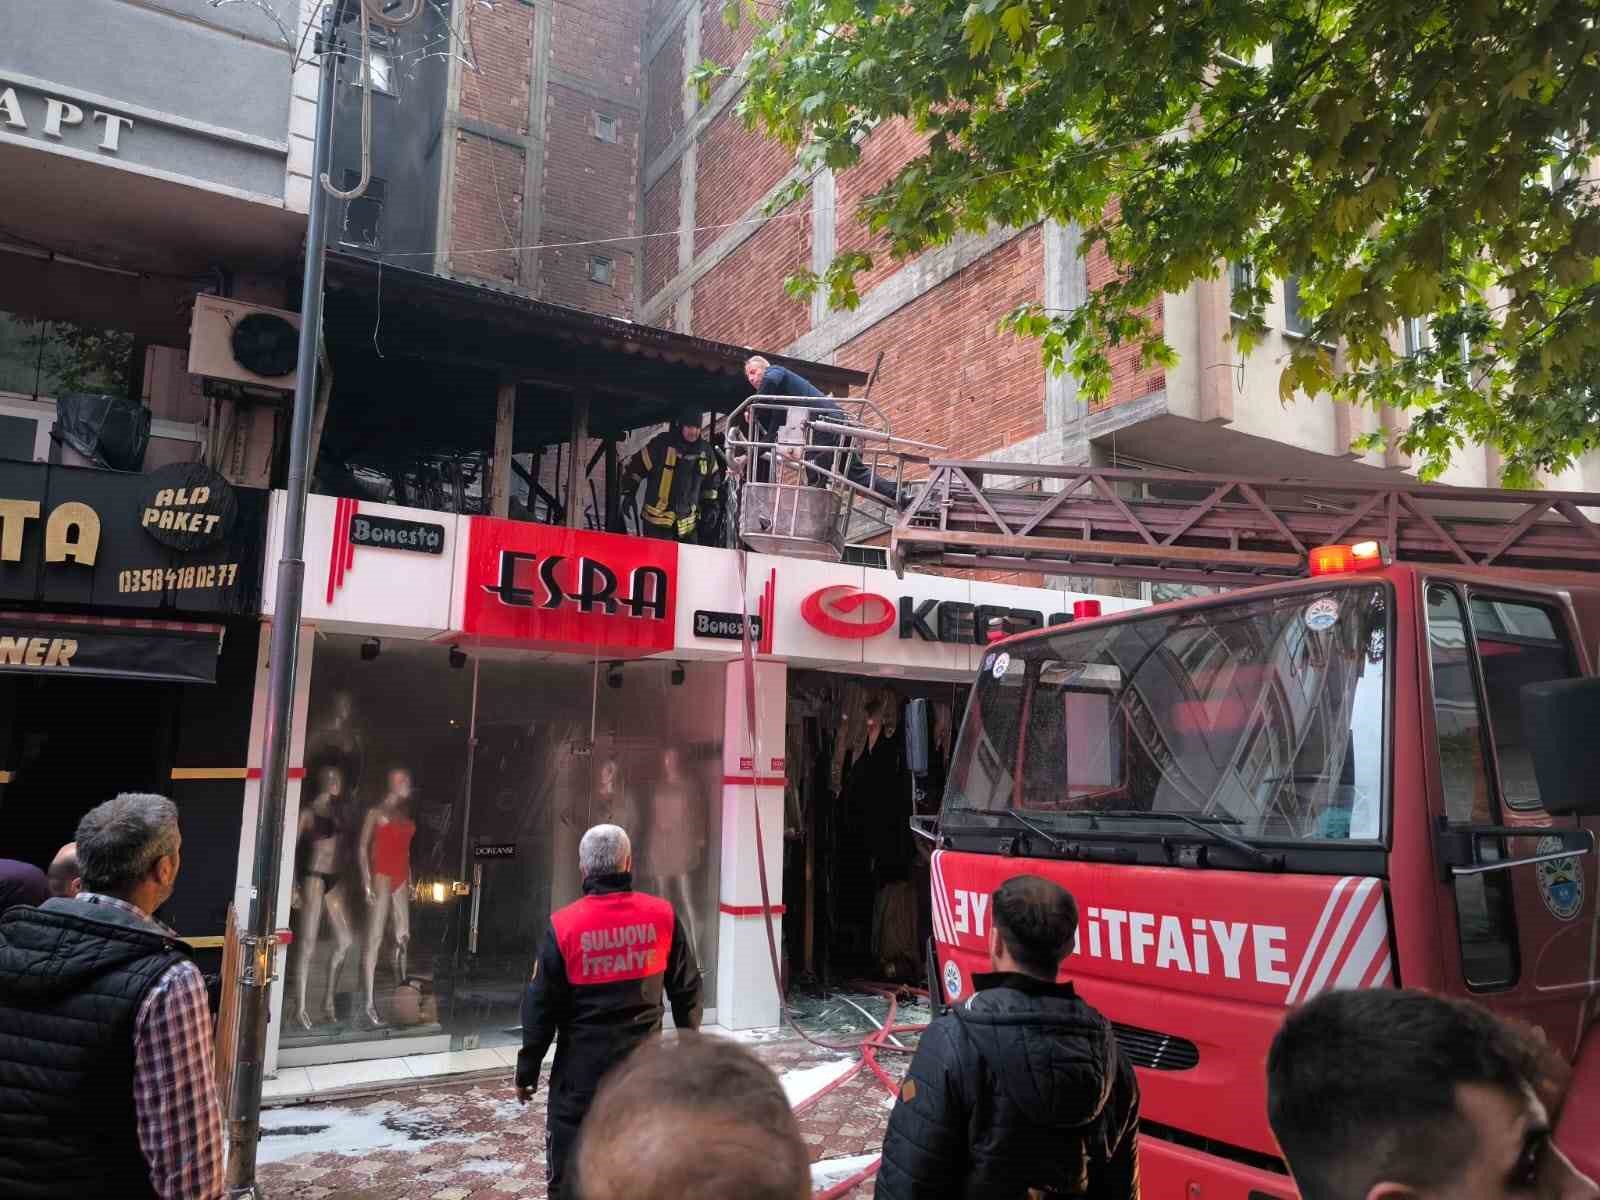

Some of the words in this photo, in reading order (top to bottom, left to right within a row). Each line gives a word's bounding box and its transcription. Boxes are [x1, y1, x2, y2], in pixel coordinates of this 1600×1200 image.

[0, 87, 134, 151] APT
[0, 499, 101, 566] TA
[142, 507, 221, 534] PAKET
[352, 516, 440, 546] Bonesta
[480, 550, 668, 620] ESRA
[696, 614, 760, 641] Bonesa
[0, 636, 79, 666] NER
[580, 922, 657, 951] SULUOVA
